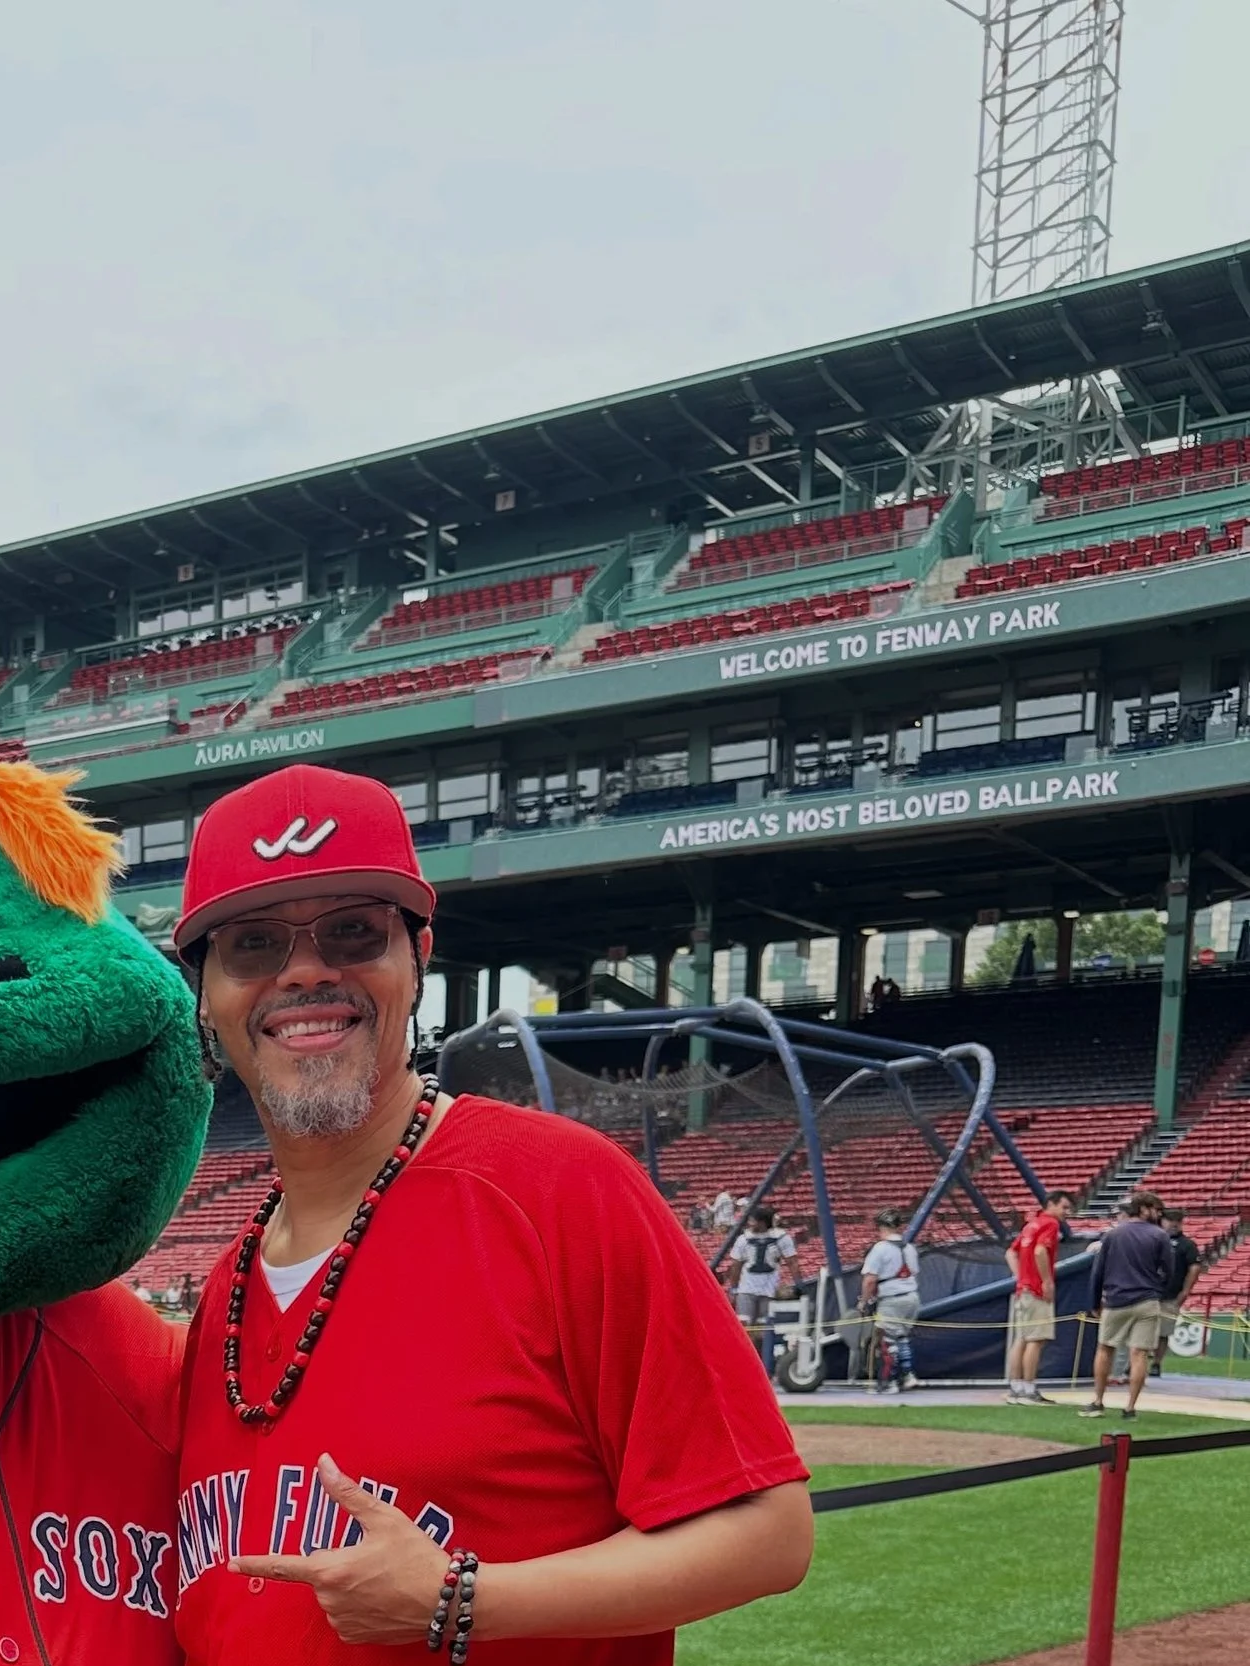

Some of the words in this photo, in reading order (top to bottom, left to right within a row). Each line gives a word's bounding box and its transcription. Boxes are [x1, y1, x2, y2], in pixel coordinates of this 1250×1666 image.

[719, 641, 829, 680] WELCOME
[837, 635, 868, 661] TO
[875, 615, 980, 655] FENWAY
[988, 602, 1061, 637] PARK
[250, 728, 325, 757] PAVILION
[658, 813, 780, 849] AMERICA'S
[786, 804, 851, 834] MOST
[858, 789, 970, 825] BELOVED
[978, 770, 1119, 811] BALLPARK
[31, 1511, 172, 1619] SOX
[176, 1469, 250, 1610] MMY
